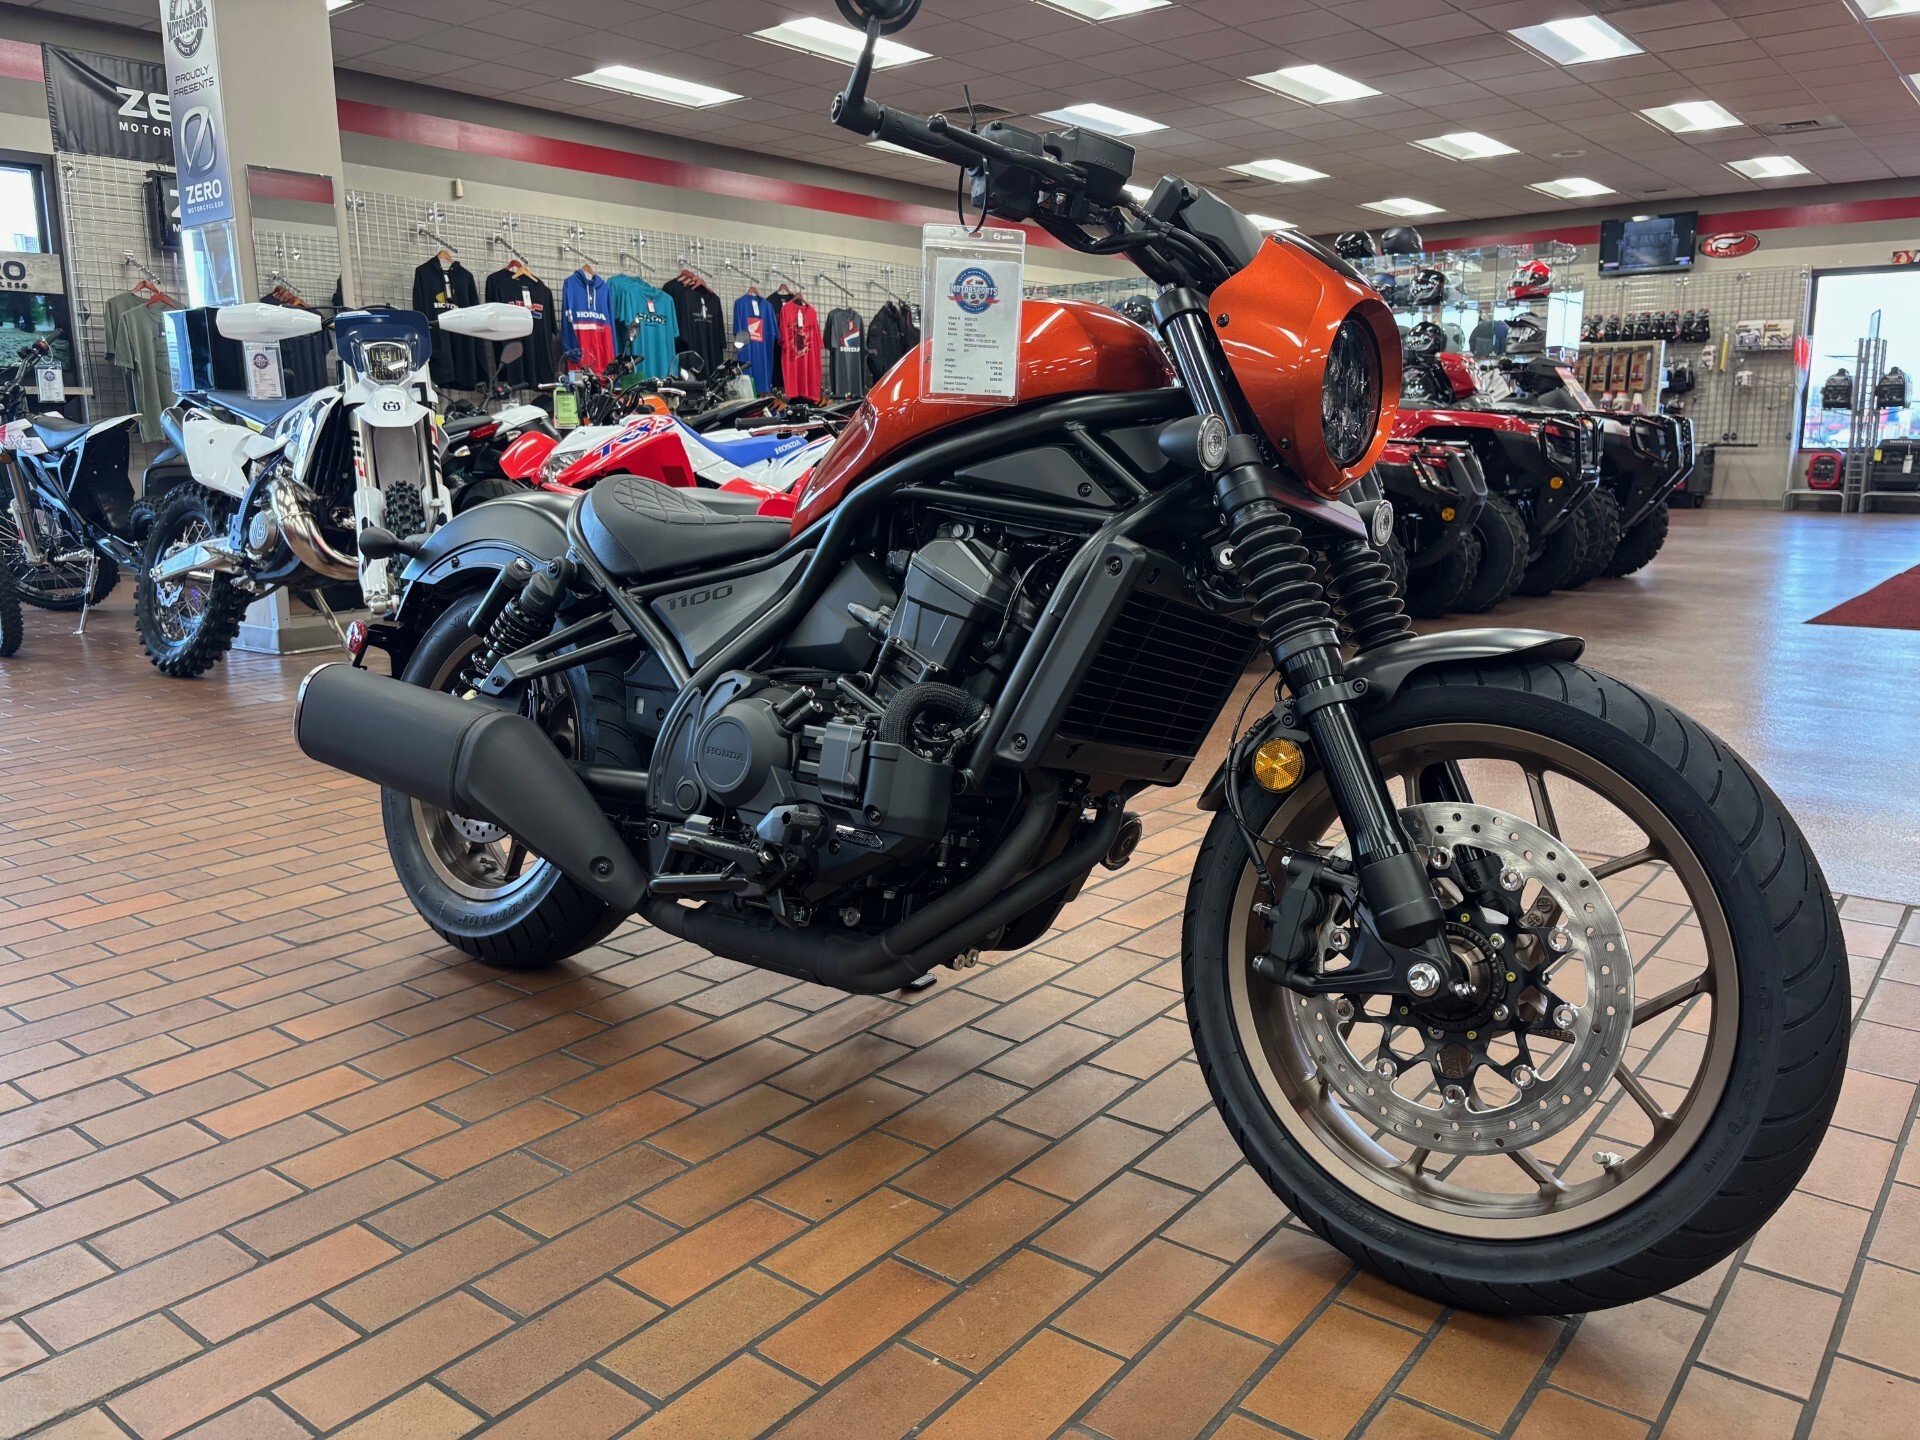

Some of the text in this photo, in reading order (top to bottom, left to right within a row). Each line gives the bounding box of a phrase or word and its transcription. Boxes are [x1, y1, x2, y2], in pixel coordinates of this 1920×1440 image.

[166, 6, 208, 43] MOTORSPORTS
[175, 64, 209, 85] PROUDLY
[173, 76, 214, 99] PRESENTS
[185, 178, 222, 205] ZERO
[950, 284, 998, 297] MOTORSPORTS
[576, 311, 606, 321] HONDA
[774, 439, 802, 455] HONDA
[665, 584, 734, 611] 1100
[706, 746, 745, 761] HONDA
